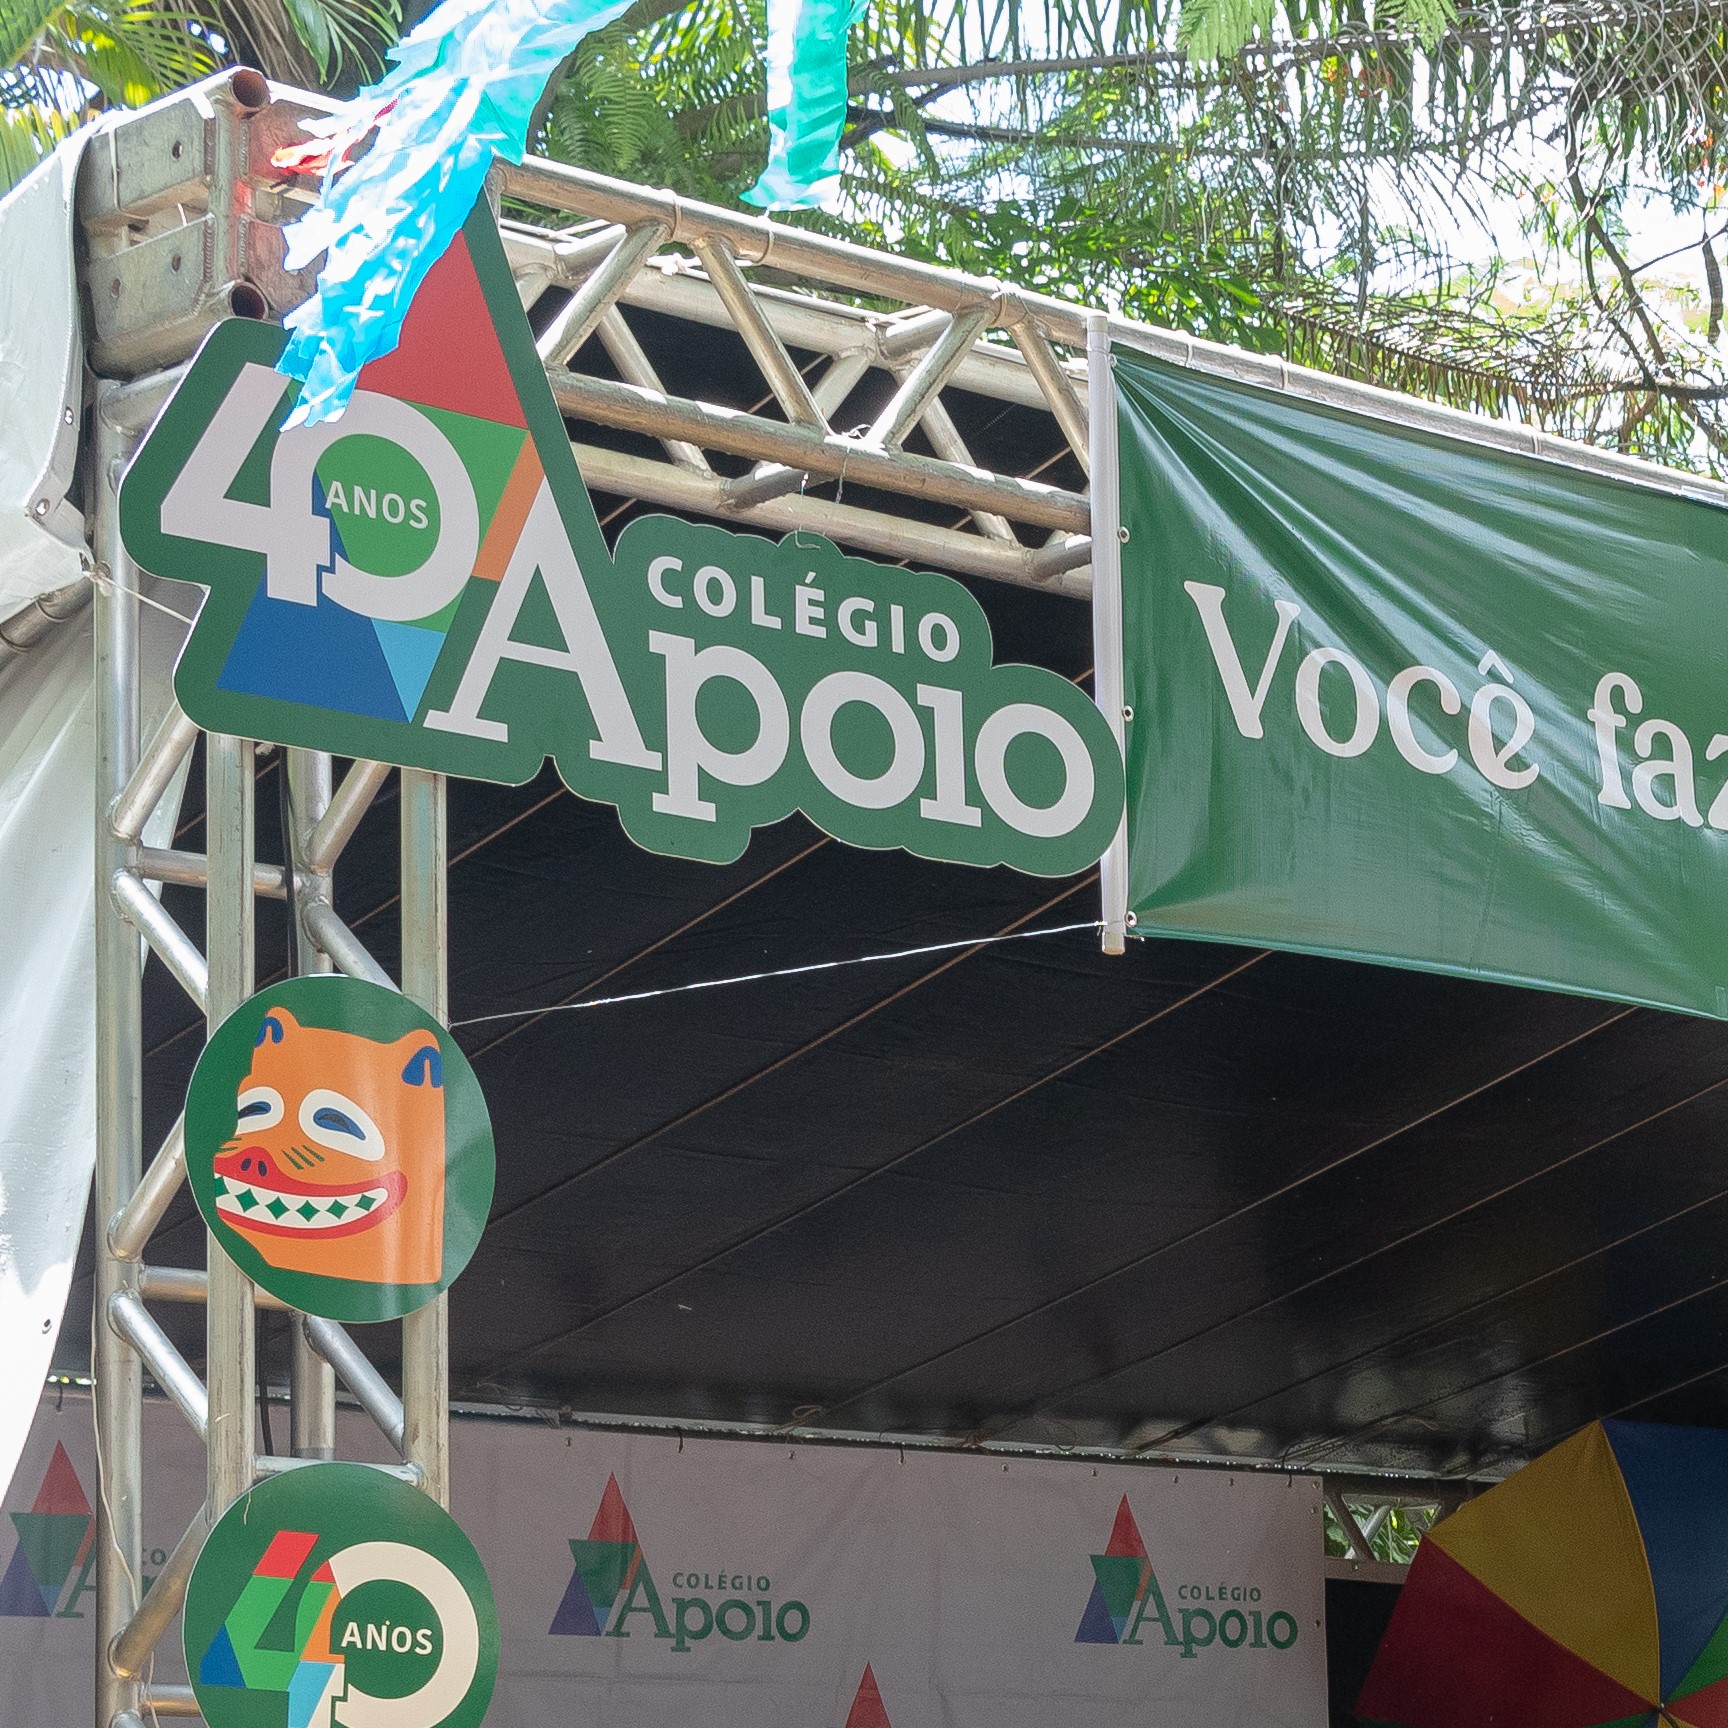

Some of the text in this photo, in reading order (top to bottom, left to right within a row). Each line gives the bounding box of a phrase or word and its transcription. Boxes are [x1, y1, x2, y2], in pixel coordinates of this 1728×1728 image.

[323, 479, 430, 531] ANOS
[424, 472, 1096, 838] Apoio
[647, 554, 962, 664] COLÉGIO
[1183, 580, 1541, 790] Você
[604, 1546, 811, 1653] Apoio
[671, 1570, 771, 1592] COLÉGIO
[1122, 1566, 1299, 1659] Apoio
[1177, 1582, 1262, 1602] COLÉGIO
[340, 1620, 434, 1656] ANOS
